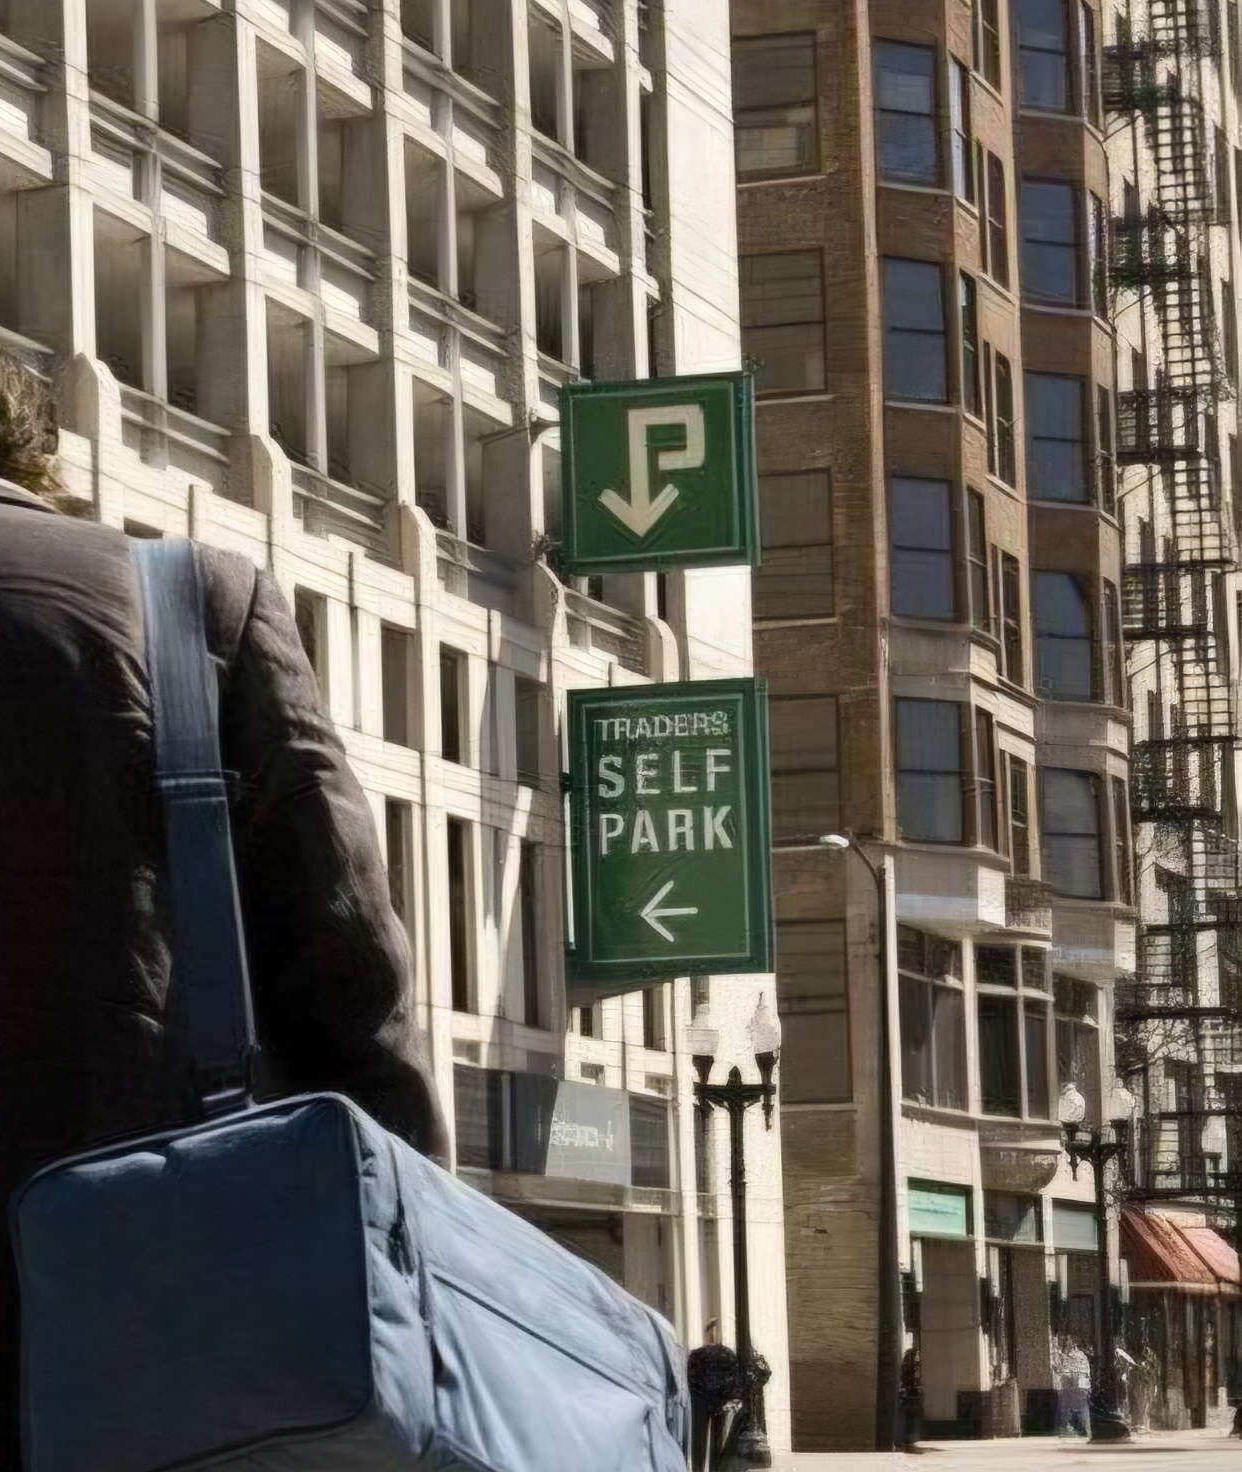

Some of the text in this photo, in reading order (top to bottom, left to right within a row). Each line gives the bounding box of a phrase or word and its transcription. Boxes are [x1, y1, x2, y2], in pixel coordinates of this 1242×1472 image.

[627, 404, 706, 538] P
[594, 710, 732, 741] TRADERS
[598, 748, 732, 798] SELF
[599, 805, 734, 855] PARK
